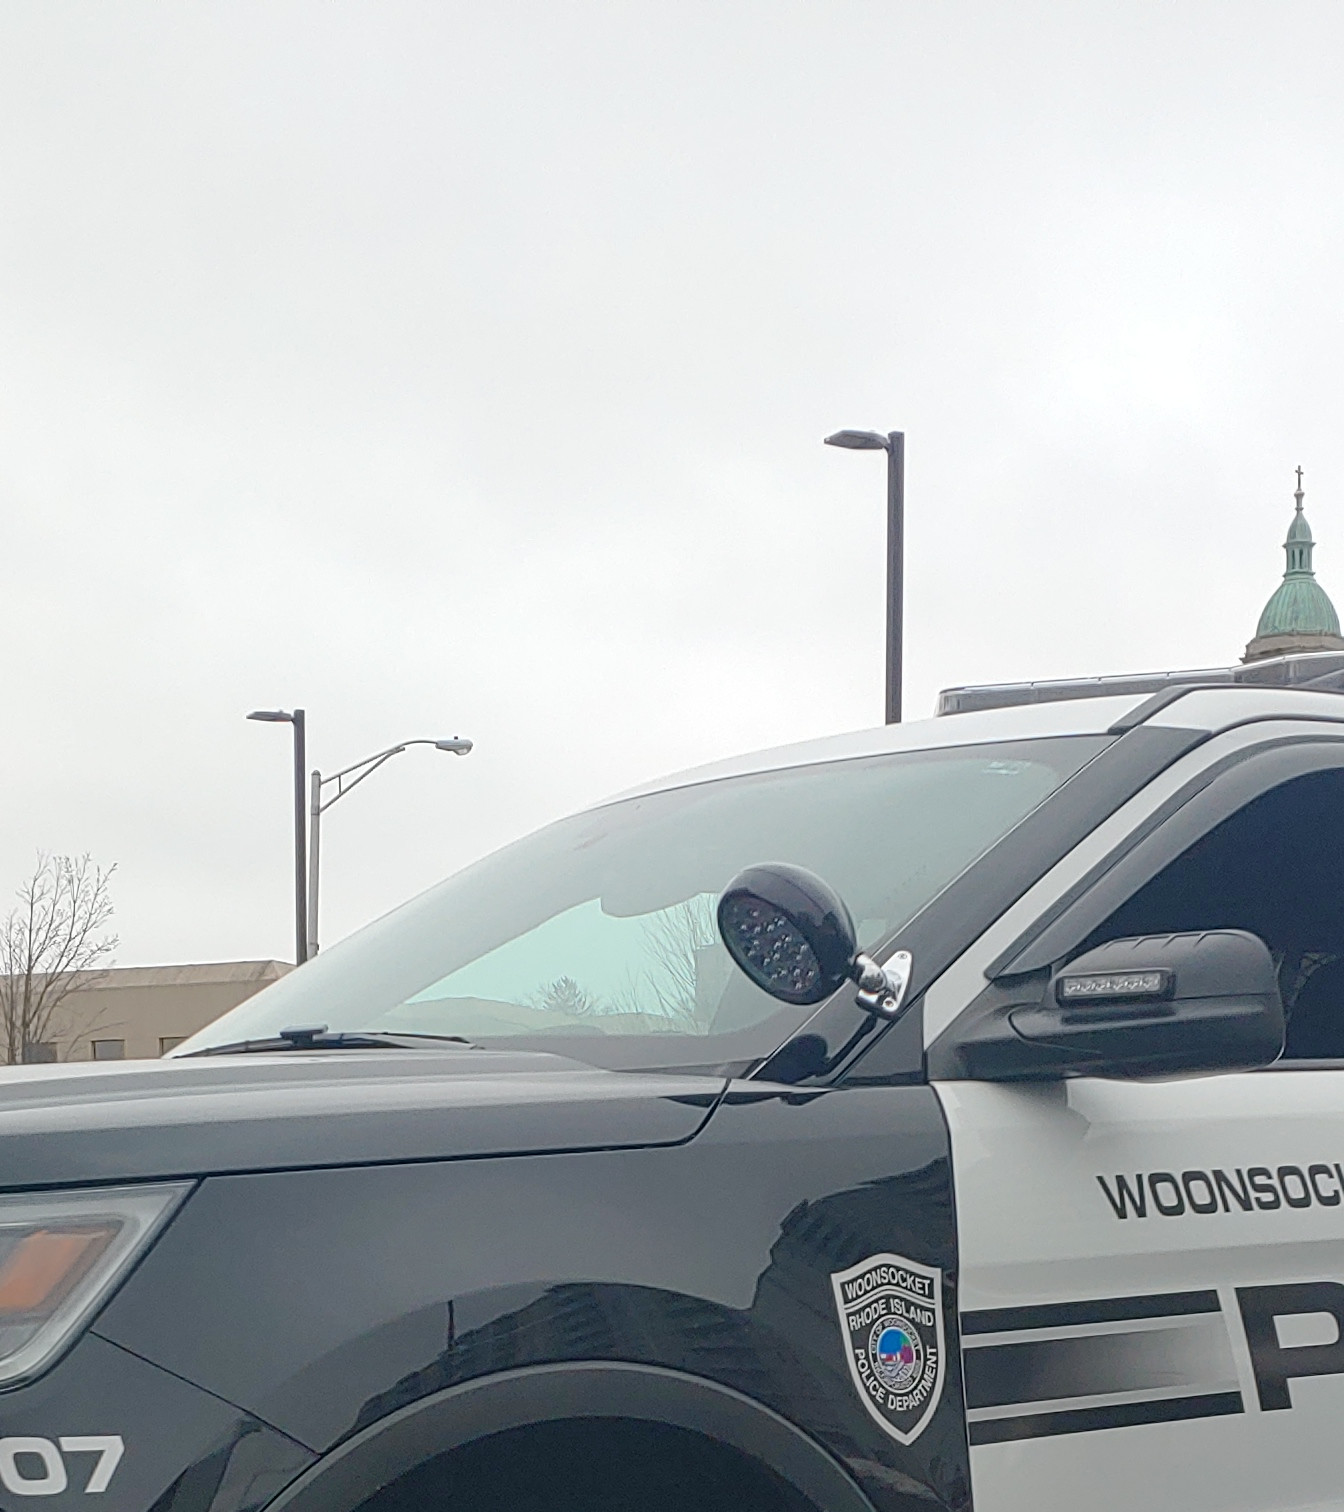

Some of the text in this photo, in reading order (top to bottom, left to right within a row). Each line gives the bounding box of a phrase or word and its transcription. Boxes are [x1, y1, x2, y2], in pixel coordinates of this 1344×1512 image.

[844, 1266, 931, 1300] WOONSOCKET
[848, 1298, 934, 1332] RHODE ISLAND
[855, 1348, 887, 1404] POLICE
[887, 1345, 938, 1411] DEPARTMENT
